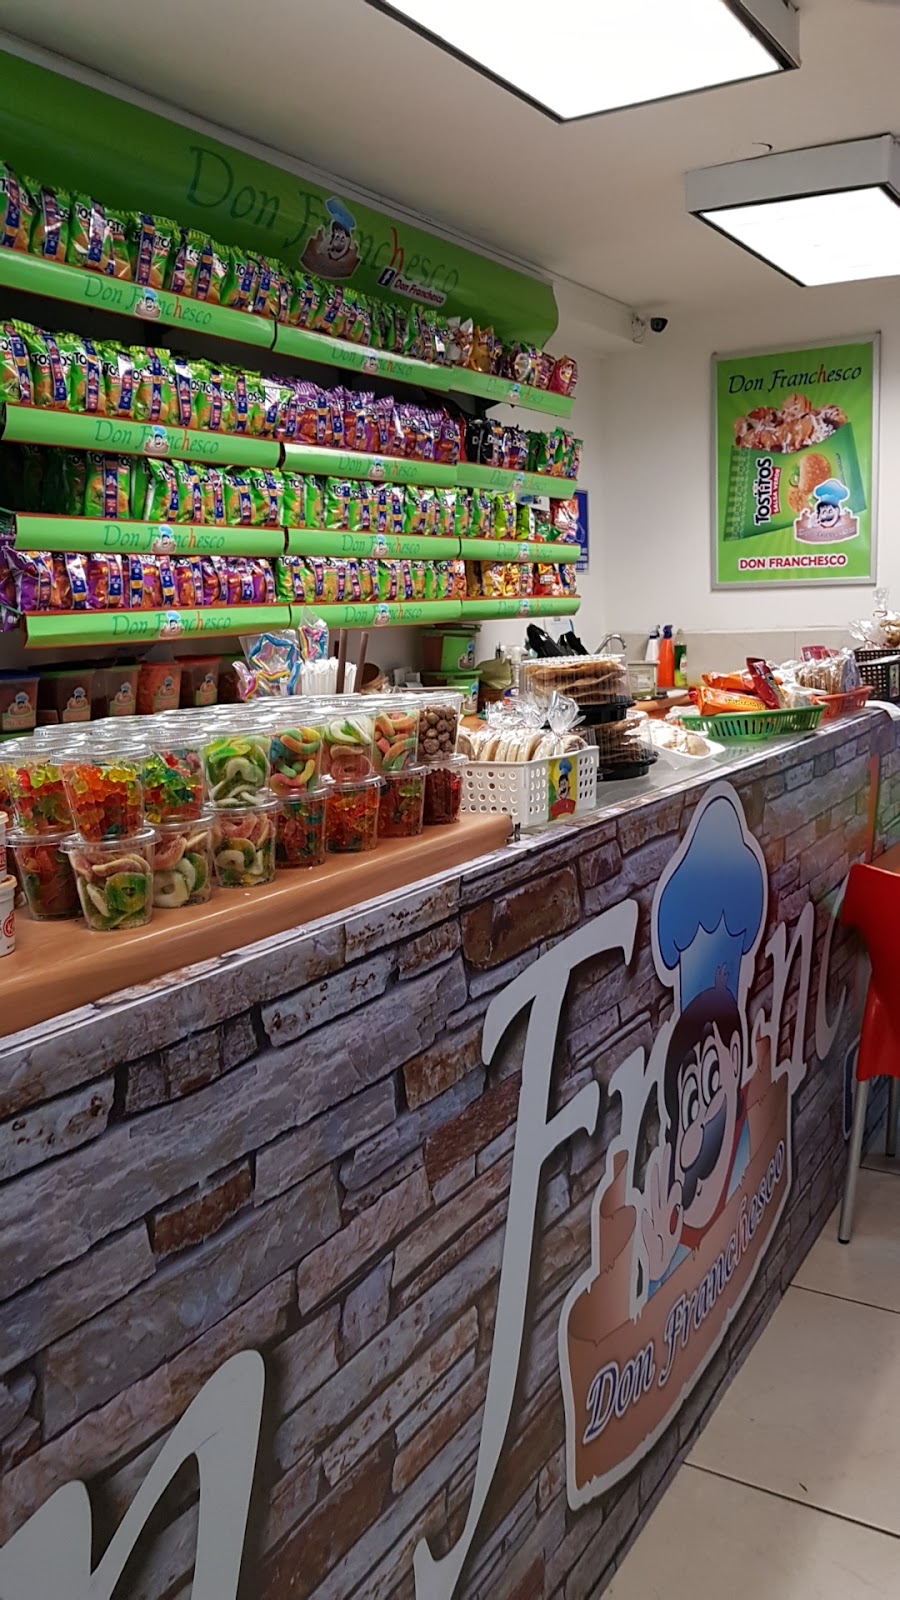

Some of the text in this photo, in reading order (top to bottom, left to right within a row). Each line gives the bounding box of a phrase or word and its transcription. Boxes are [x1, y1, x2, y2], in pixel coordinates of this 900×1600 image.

[187, 146, 459, 292] Don Fnchesco
[84, 274, 212, 325] Don Fnchesco
[728, 364, 862, 394] Don Franchesco
[94, 420, 219, 453] Don Fnchesco
[339, 456, 362, 472] Don
[103, 525, 225, 549] Don Fnchesco
[342, 534, 365, 551] Don
[740, 555, 846, 569] DON FRANCHESCO
[112, 611, 231, 636] Don Fnchesco
[344, 606, 368, 623] Don
[584, 1140, 785, 1443] Don Franchesco
